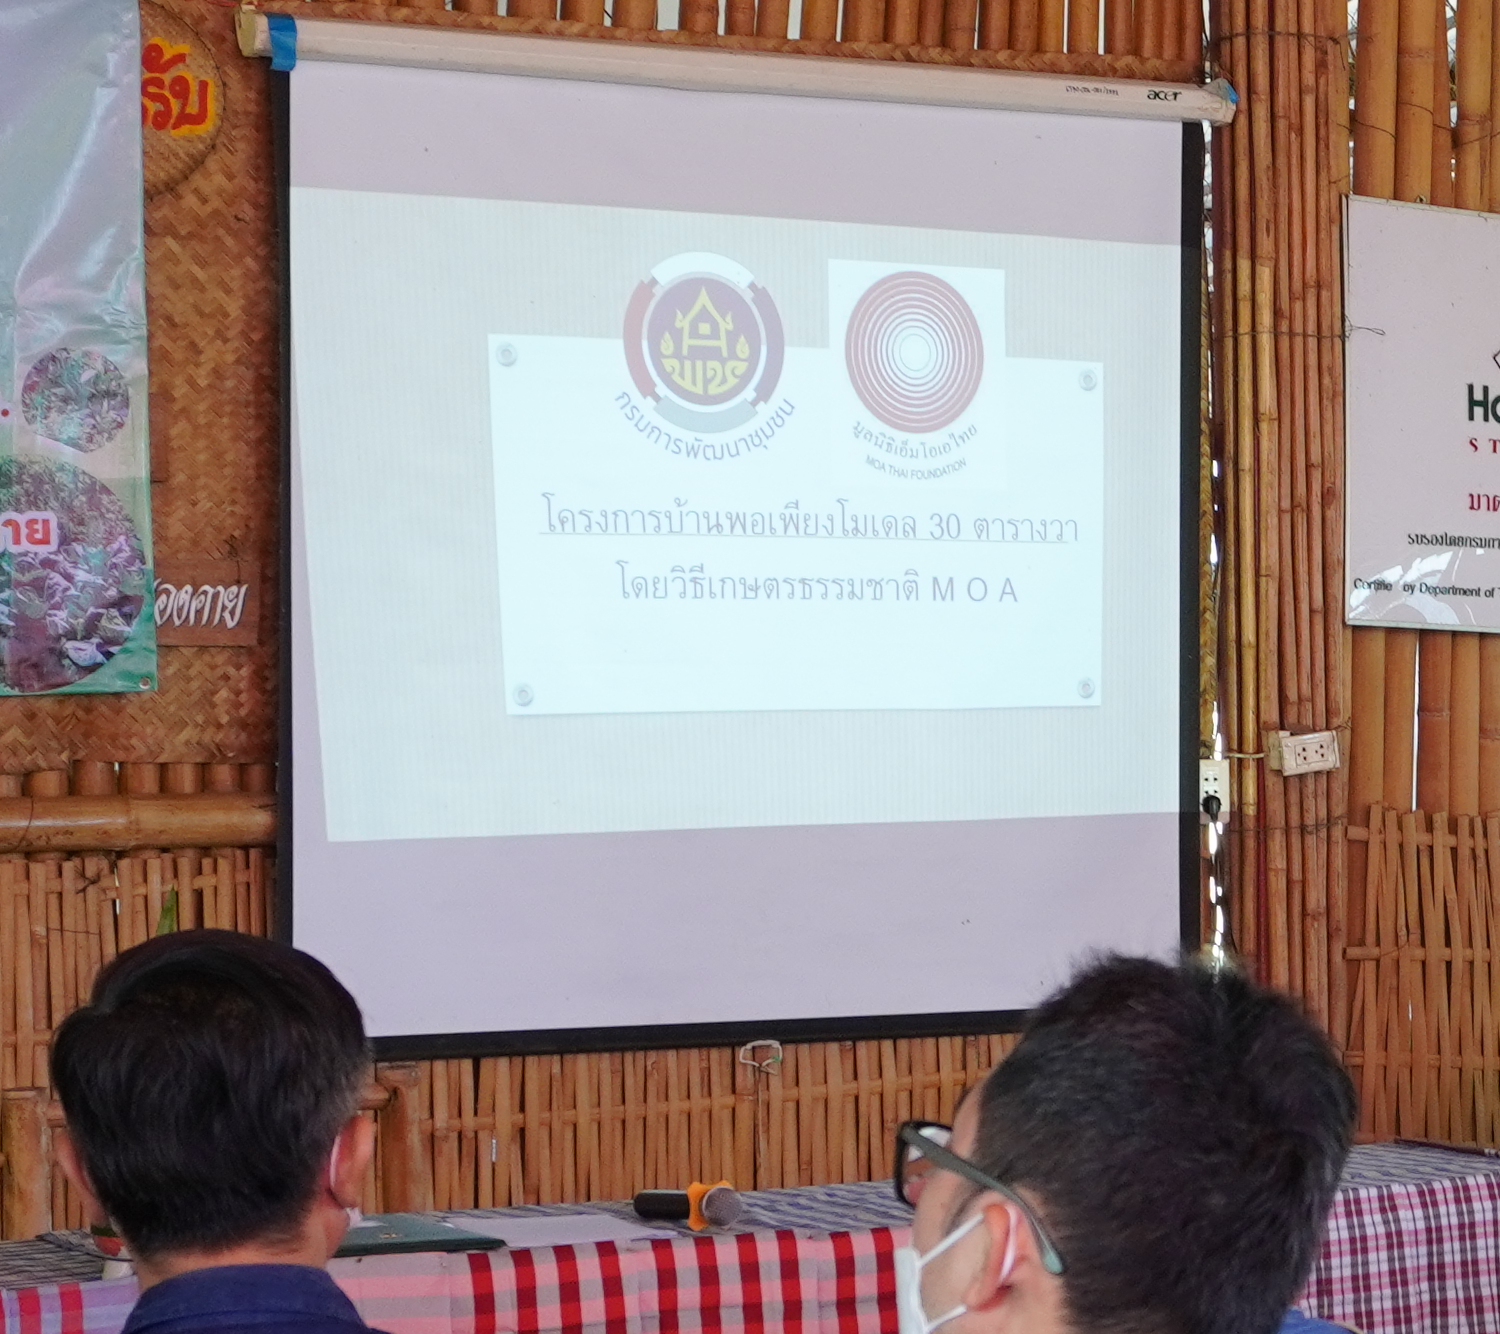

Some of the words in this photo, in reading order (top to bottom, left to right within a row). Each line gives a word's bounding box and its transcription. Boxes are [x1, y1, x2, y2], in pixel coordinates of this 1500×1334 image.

[1146, 88, 1183, 102] acer
[614, 389, 796, 461] กรมการพัฒนาชุมชน
[865, 454, 888, 473] MOA
[887, 464, 909, 480] THAI
[910, 457, 968, 481] FOUNDATION
[541, 492, 918, 539] โครงการบ้านพอเพียงโมเดล
[929, 512, 961, 540] 30
[973, 516, 1079, 543] ตารางวา
[616, 559, 920, 601] โดยวิธีเกษตรธรรมชาติ
[1418, 582, 1482, 599] Department
[1484, 587, 1496, 599] of
